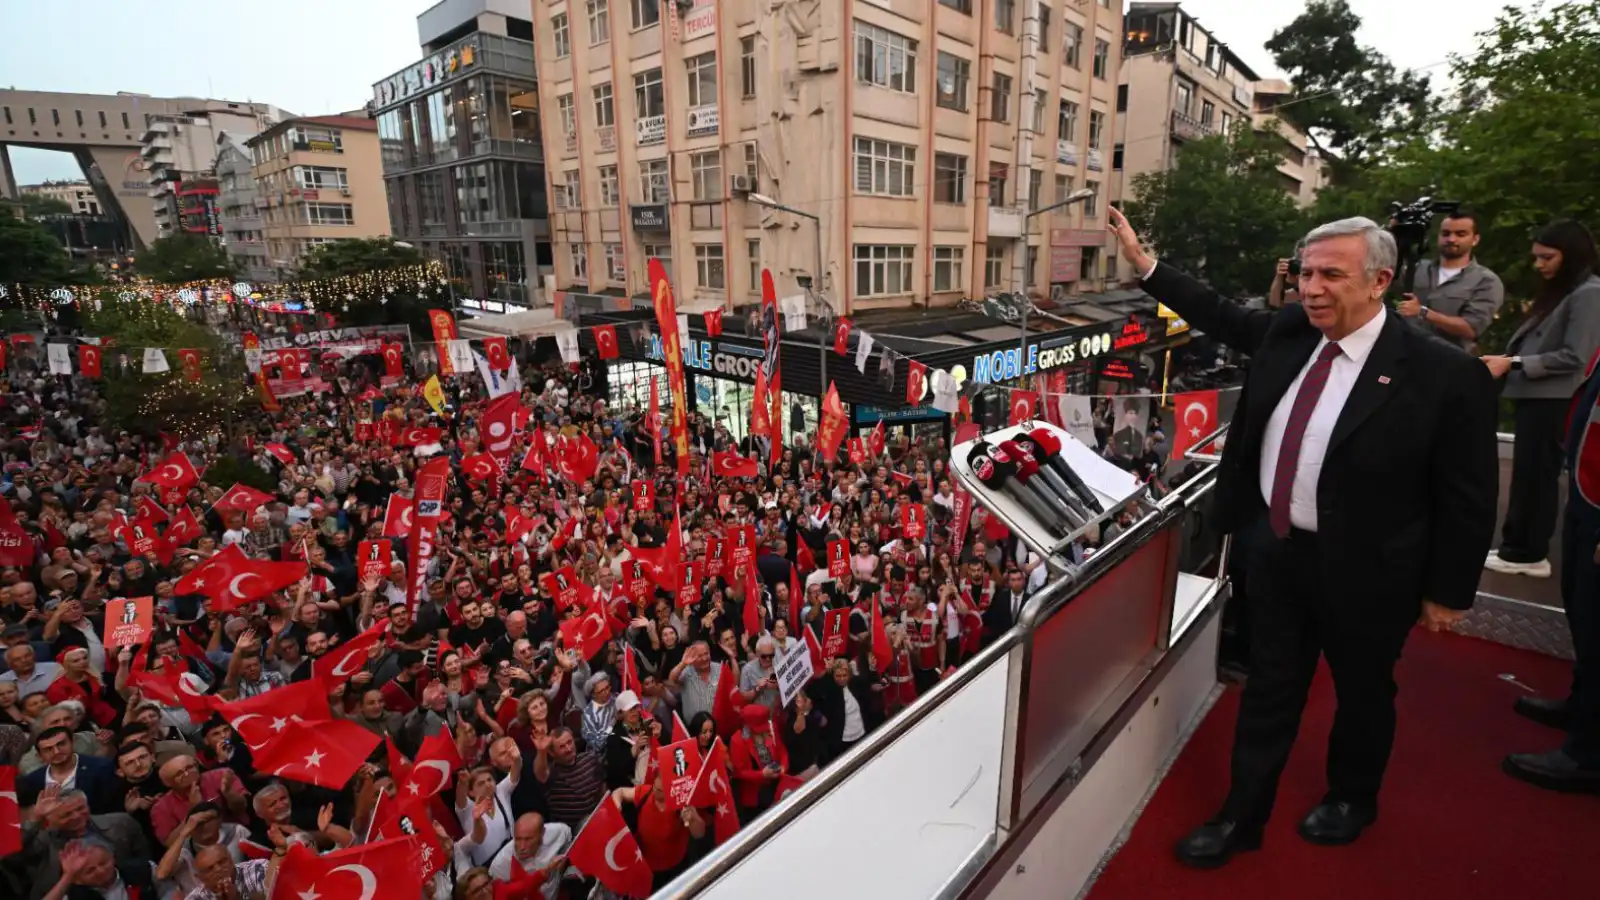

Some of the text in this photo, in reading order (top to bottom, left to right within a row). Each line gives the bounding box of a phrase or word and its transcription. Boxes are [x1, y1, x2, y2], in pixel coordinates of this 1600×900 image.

[686, 12, 715, 33] TERCÜ
[645, 116, 665, 128] AVUKA
[651, 333, 712, 370] MILE
[974, 343, 1075, 384] MOBIE GROSS
[418, 501, 439, 514] CHP
